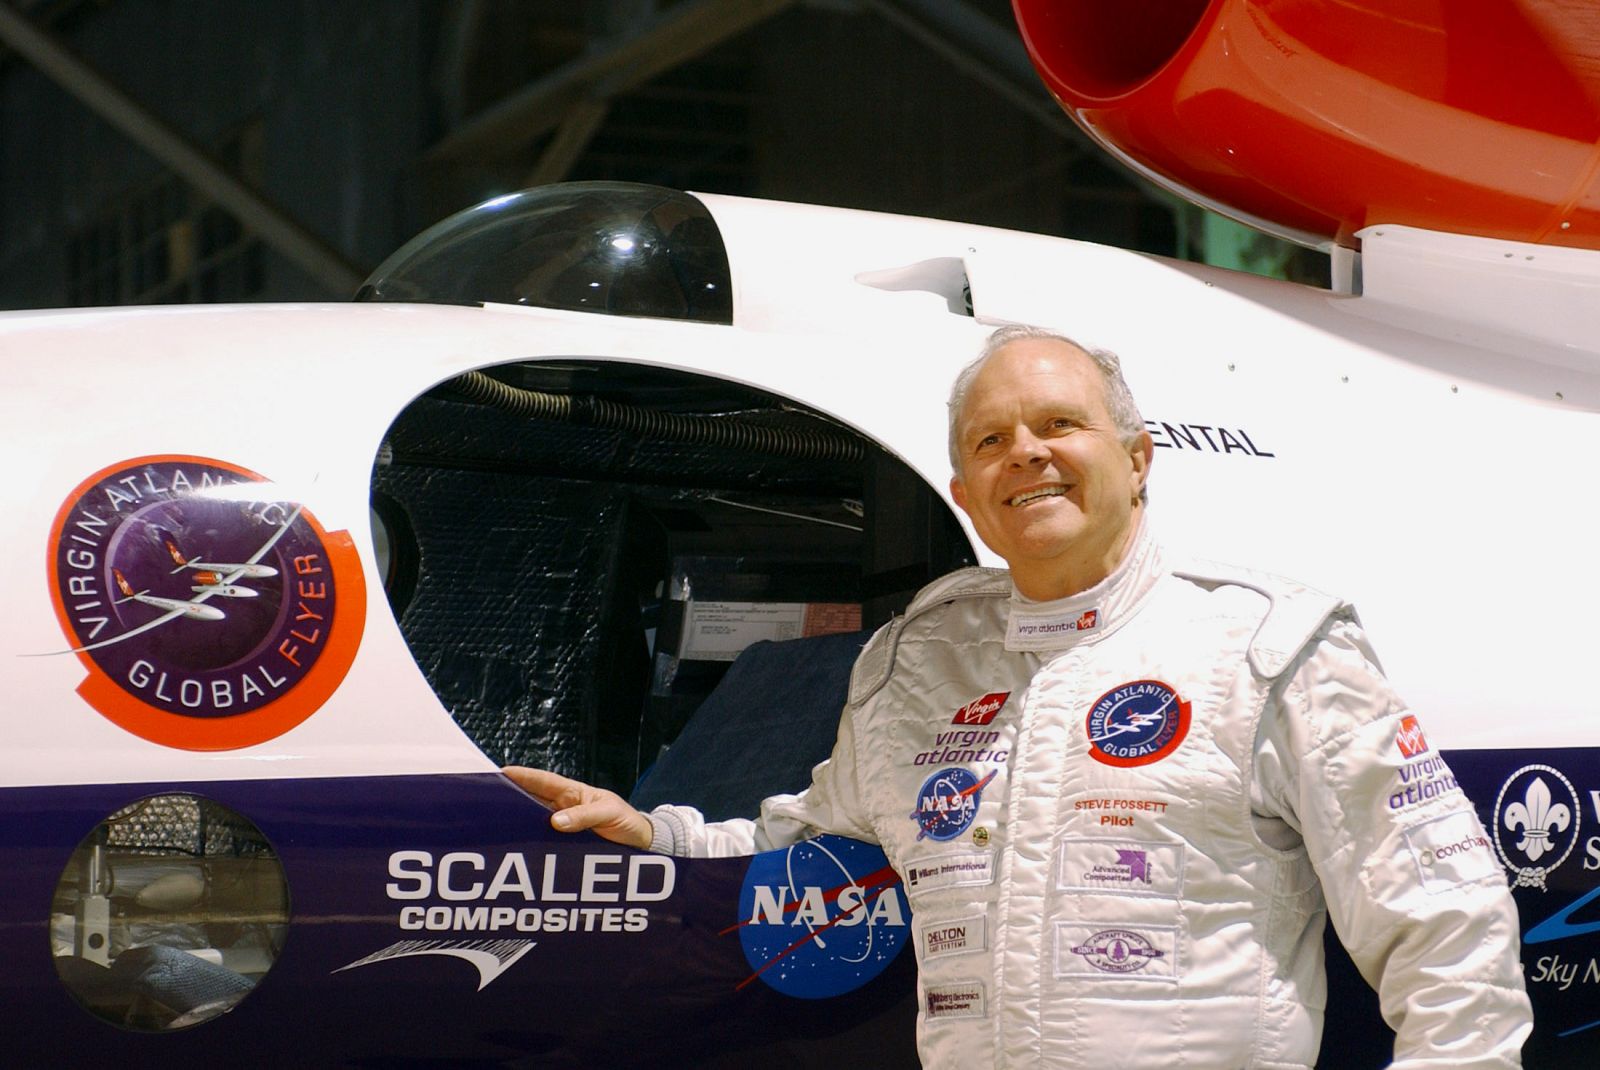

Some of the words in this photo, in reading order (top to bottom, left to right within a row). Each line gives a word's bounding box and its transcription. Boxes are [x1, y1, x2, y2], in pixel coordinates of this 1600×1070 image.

[67, 510, 109, 639] VIRGIN
[105, 469, 287, 526] ATLANC
[128, 659, 287, 708] GLOBAL
[278, 553, 327, 667] FLYER
[1038, 621, 1076, 633] atlantic
[963, 697, 1000, 724] Virgin
[1091, 699, 1113, 739] VIRGIN
[1114, 684, 1172, 704] ATLANTIC
[936, 730, 1000, 748] virgin
[1103, 742, 1157, 757] GLOBAL
[914, 746, 1009, 766] atlantic
[922, 794, 976, 812] NASA
[1389, 775, 1459, 810] atlanti
[1074, 799, 1111, 811] STEVE
[1113, 799, 1168, 813] FOSSETT
[1100, 815, 1134, 827] Pilot
[386, 850, 677, 903] SCALED
[941, 862, 988, 874] International
[1092, 865, 1130, 874] Advanced
[749, 885, 906, 928] NASA
[400, 906, 649, 933] COMPOSITES
[1531, 954, 1579, 991] Sky
